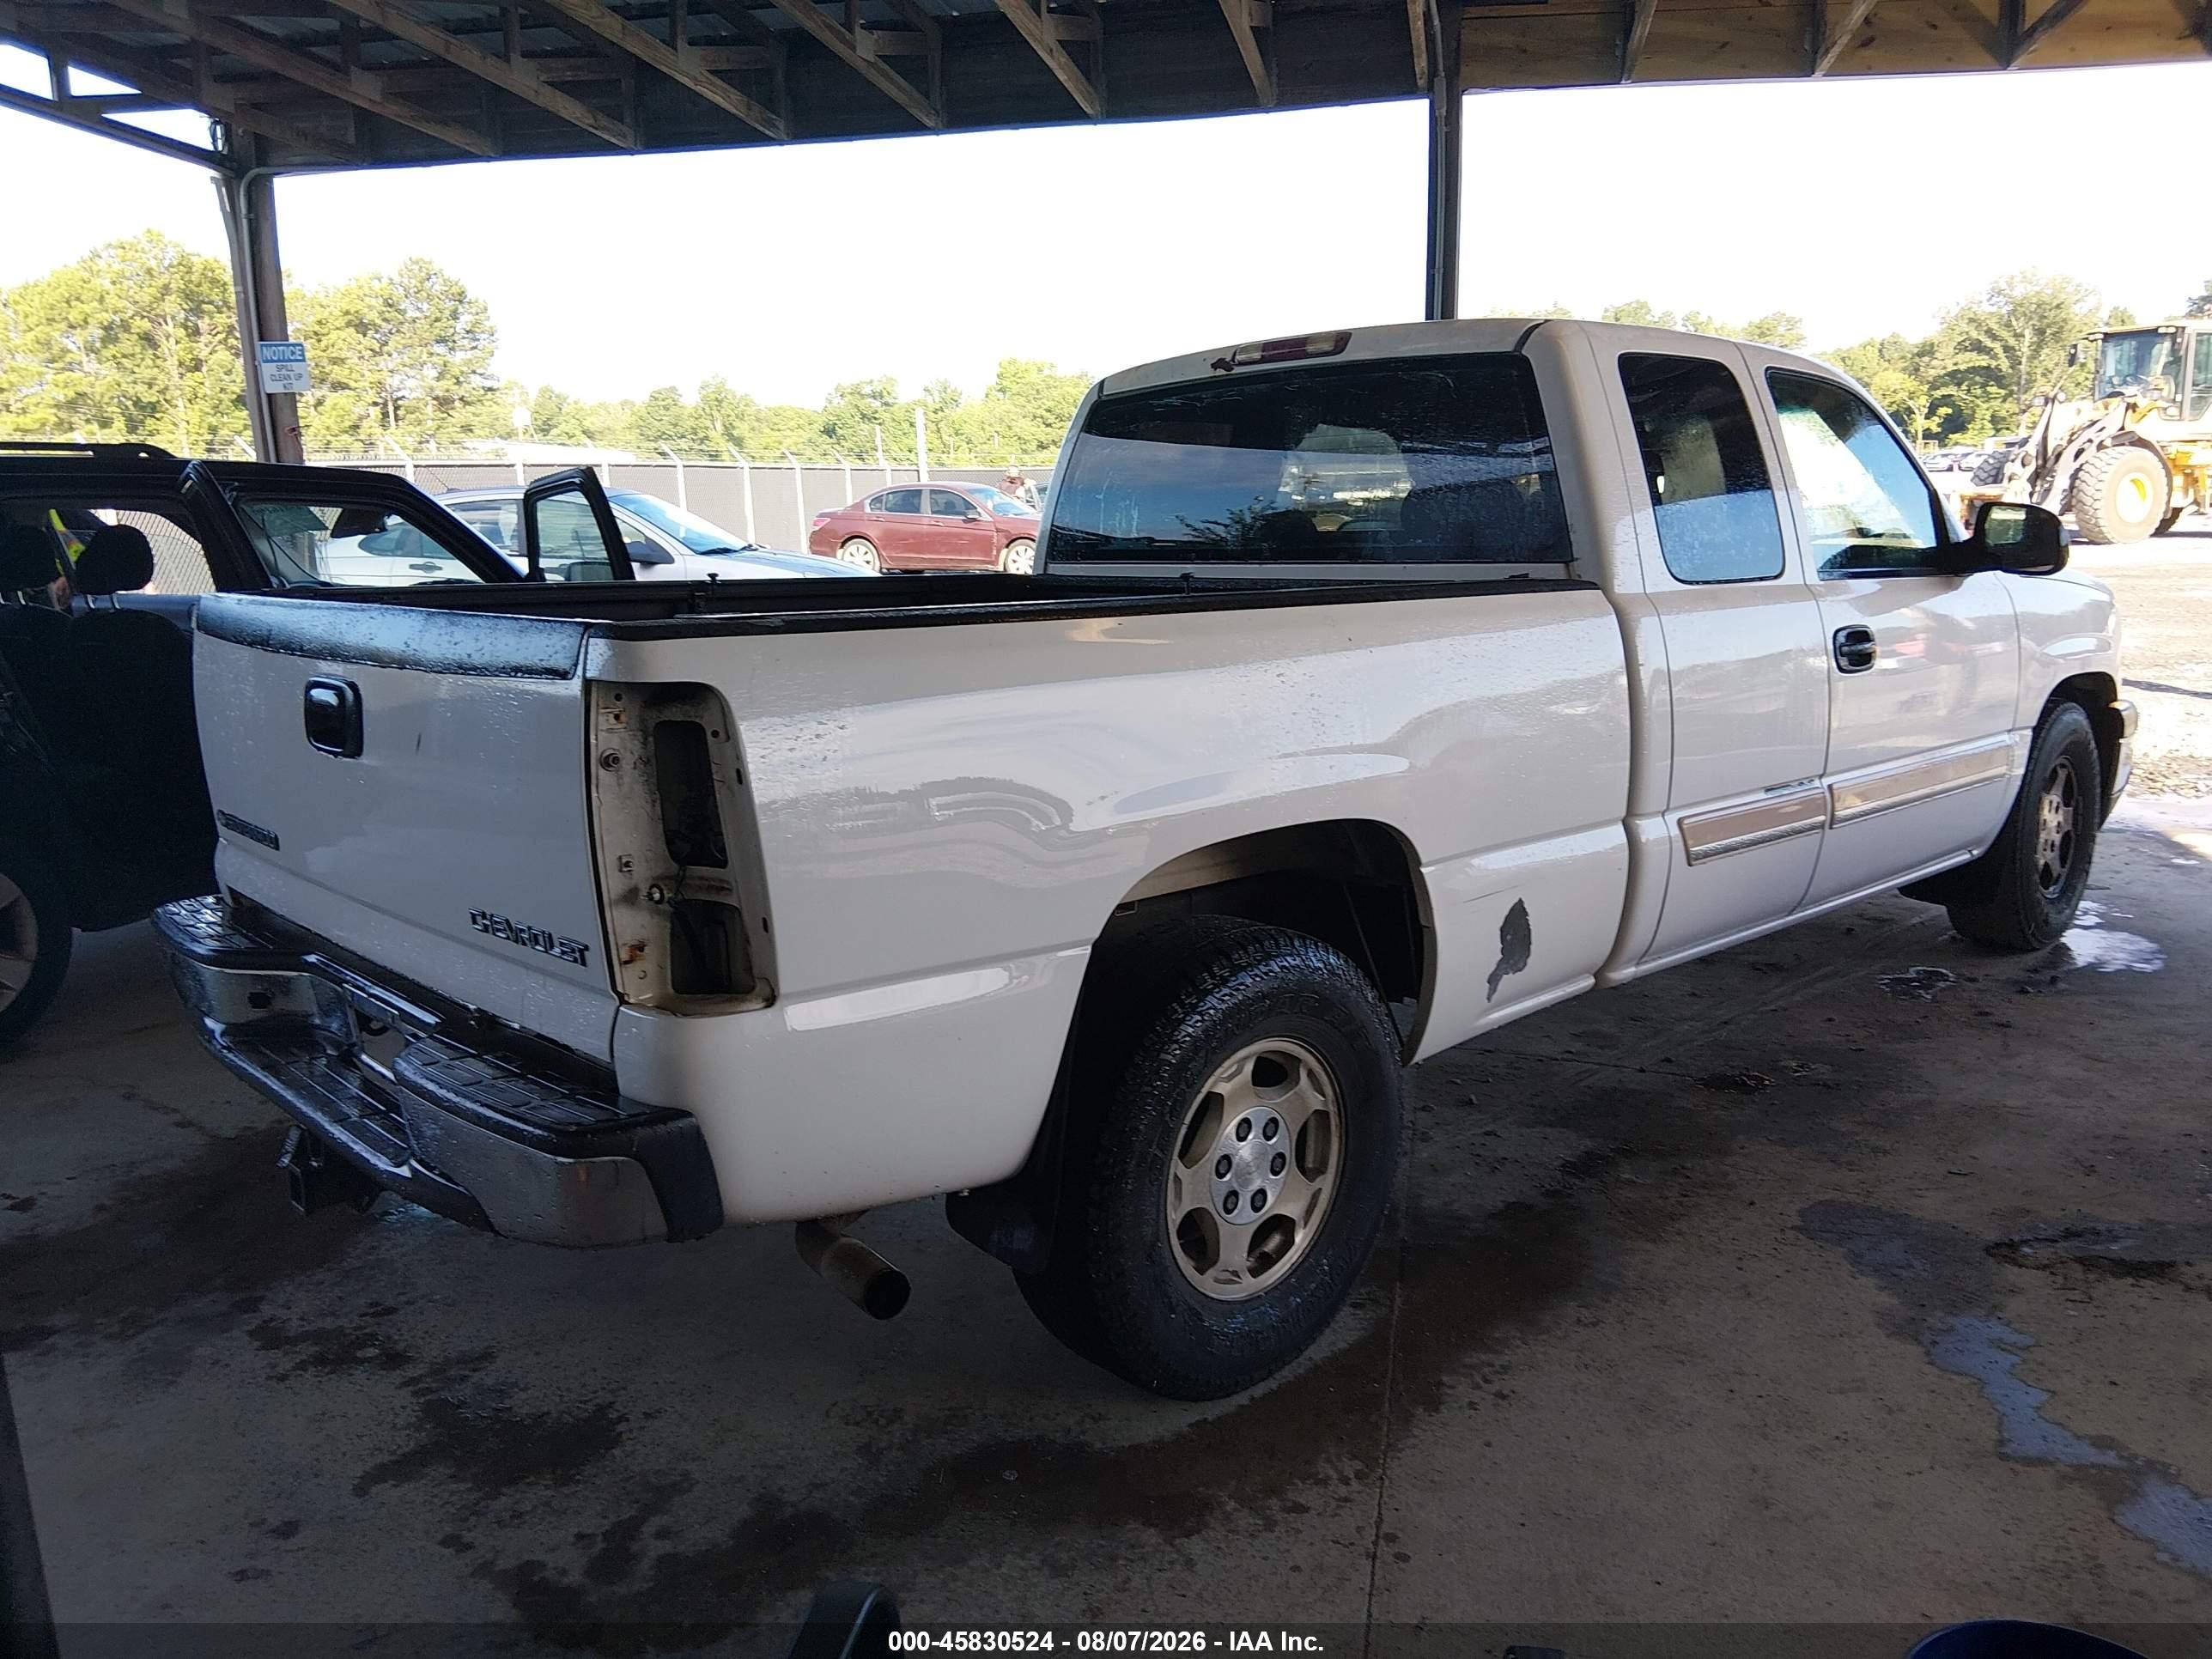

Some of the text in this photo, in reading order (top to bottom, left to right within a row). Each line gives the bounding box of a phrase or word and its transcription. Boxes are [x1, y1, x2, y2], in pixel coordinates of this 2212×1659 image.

[262, 346, 303, 360] NOTICE
[270, 374, 292, 382] CLEAN
[468, 907, 590, 967] CHEVROLET
